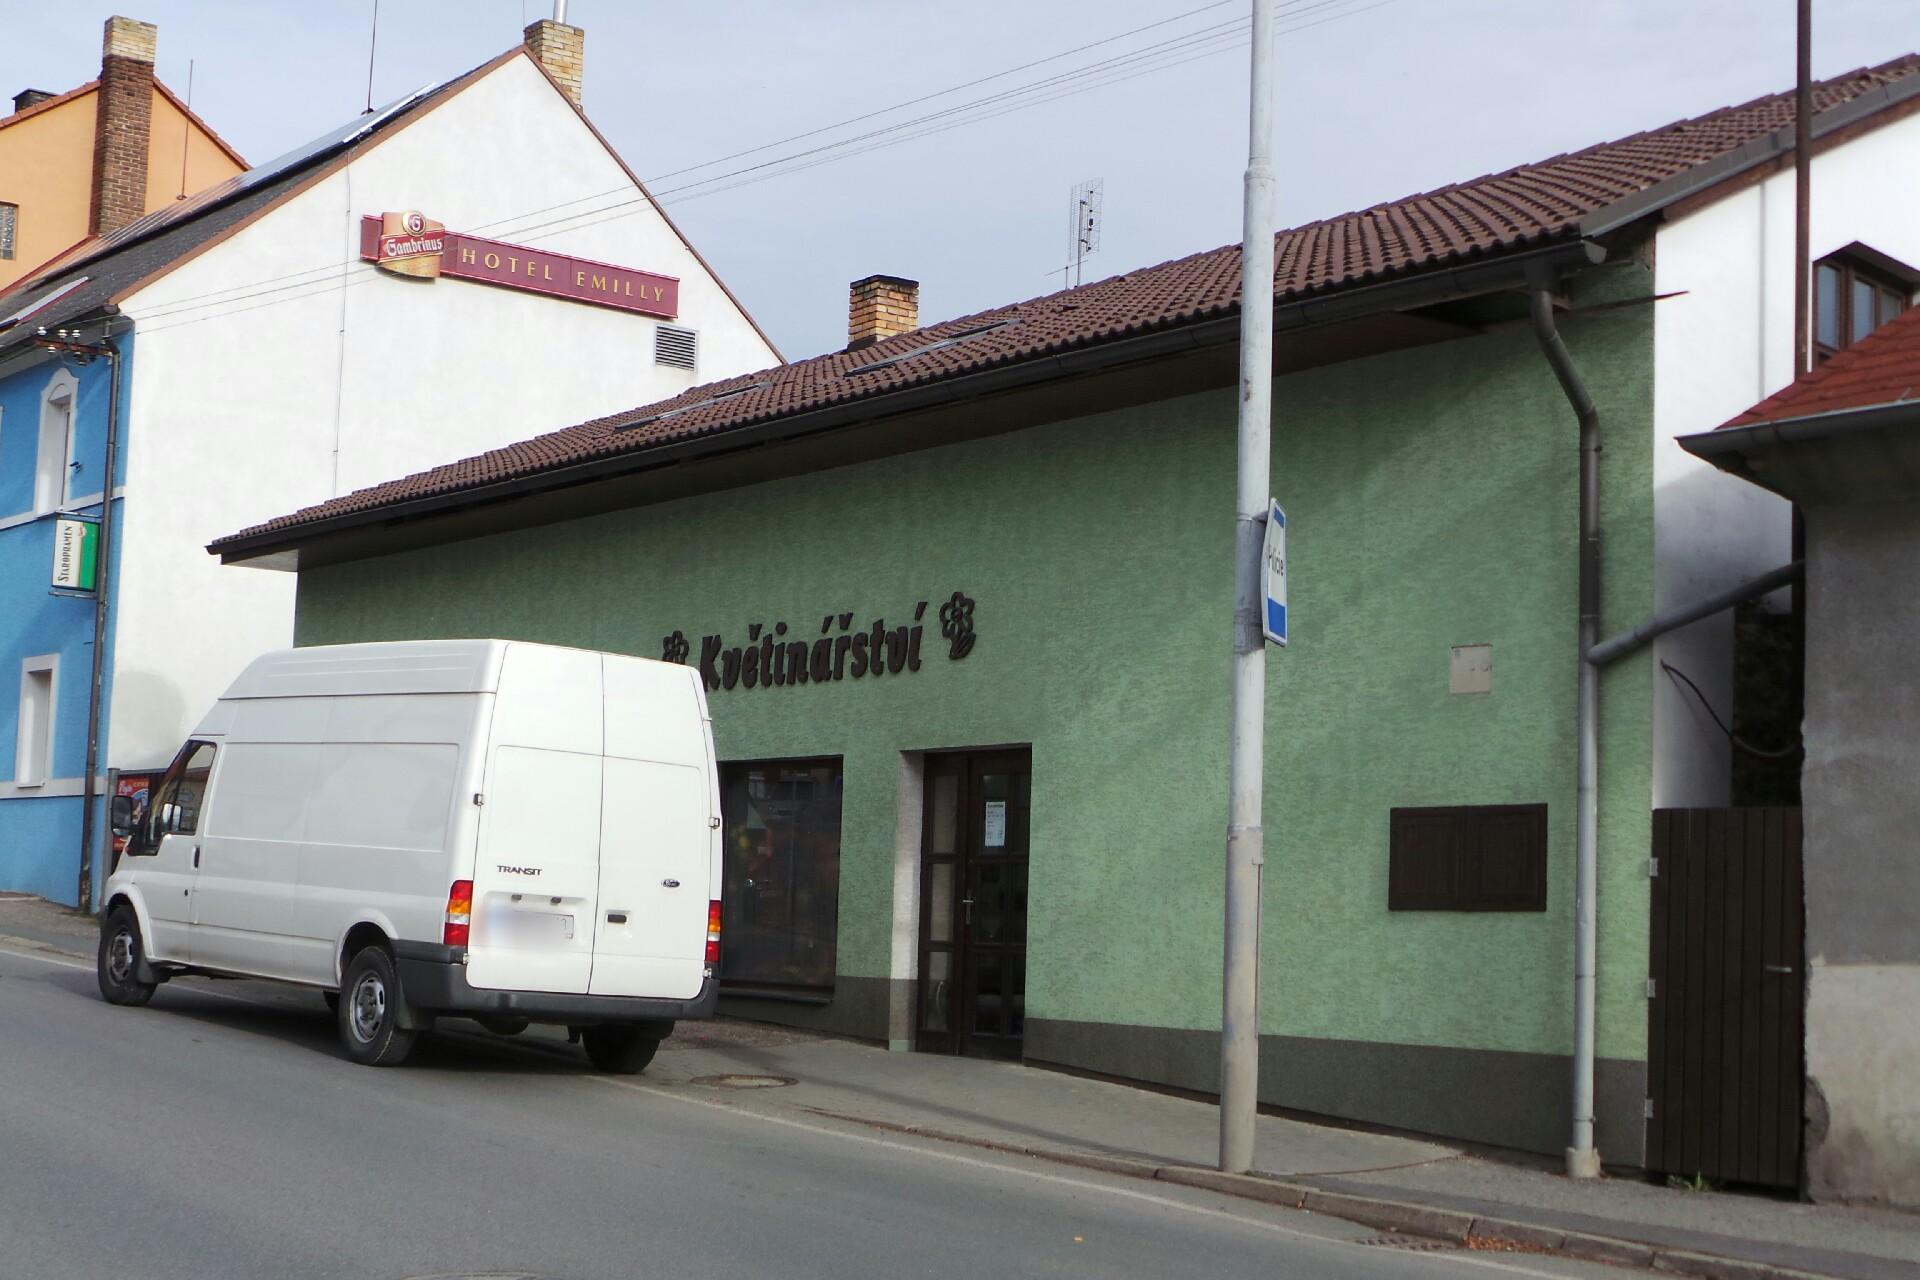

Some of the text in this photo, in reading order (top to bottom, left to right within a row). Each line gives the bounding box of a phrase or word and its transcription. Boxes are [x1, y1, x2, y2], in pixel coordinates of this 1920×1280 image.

[384, 237, 443, 257] Gambrinus
[462, 247, 665, 302] HOTEL EMILLY
[700, 601, 928, 692] Květinářství
[497, 865, 543, 876] TRANSIT
